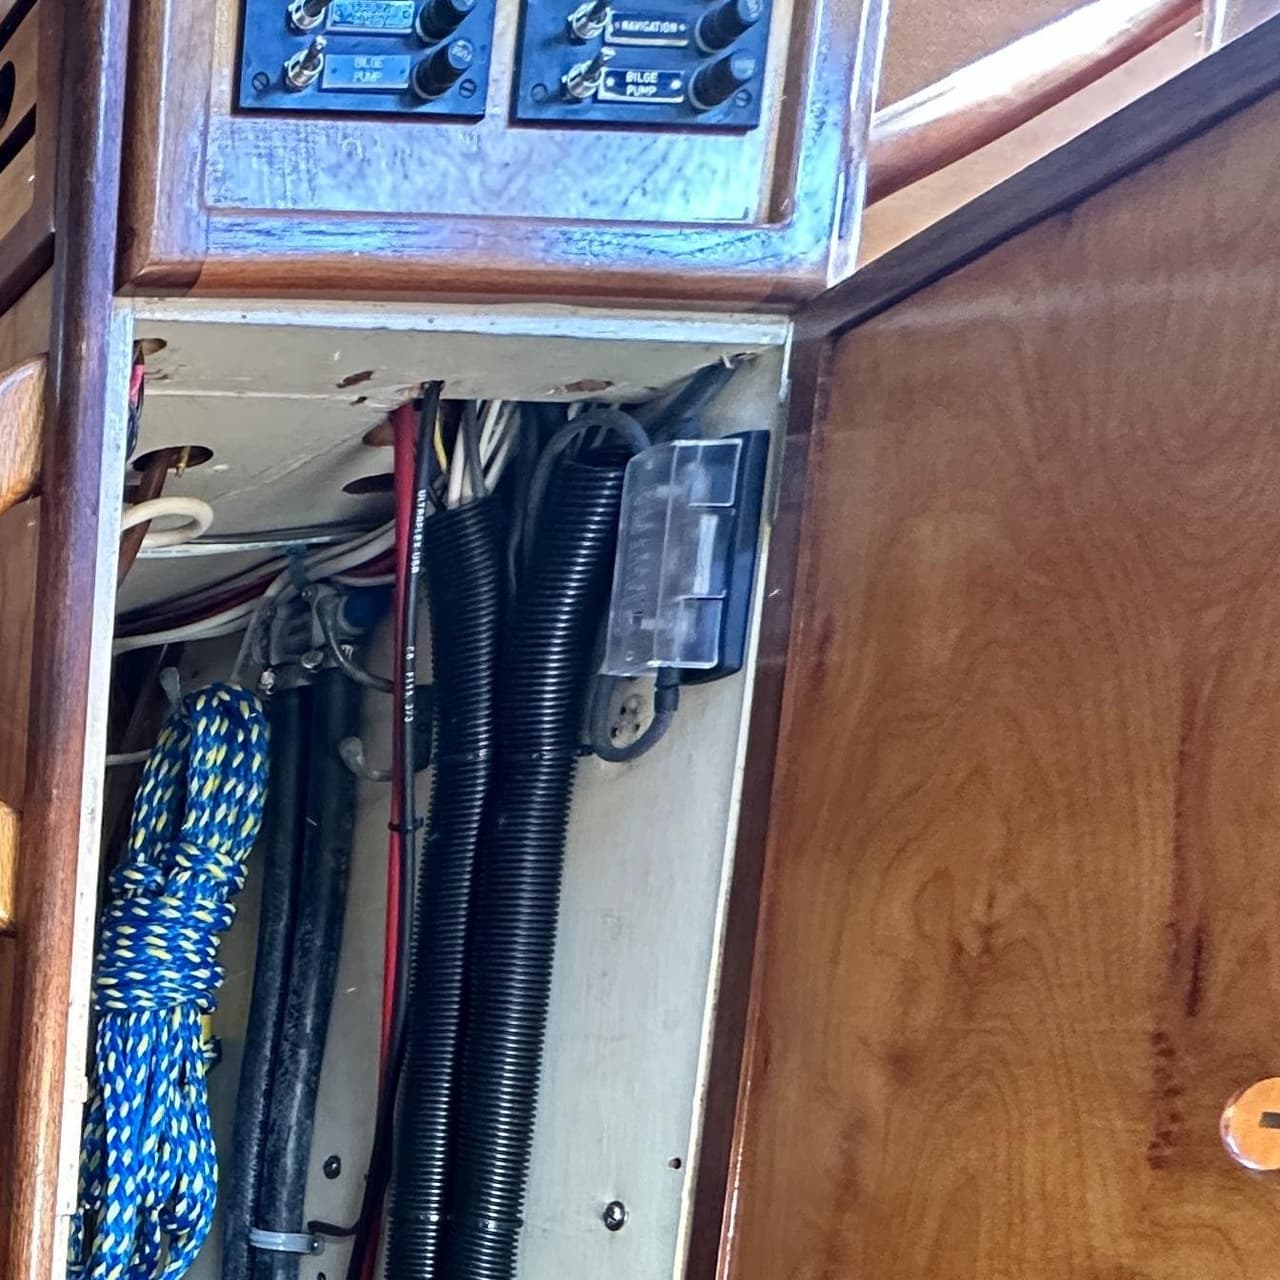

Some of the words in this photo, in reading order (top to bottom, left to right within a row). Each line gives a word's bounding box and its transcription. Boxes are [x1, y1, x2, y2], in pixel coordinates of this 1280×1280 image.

[621, 20, 678, 33] NAVIGATION
[354, 56, 384, 69] BILGE
[352, 71, 383, 83] PUMP
[625, 71, 657, 83] BILGE
[626, 84, 657, 96] PUMP
[413, 489, 427, 548] ULTRAFLEX
[410, 551, 421, 574] USA
